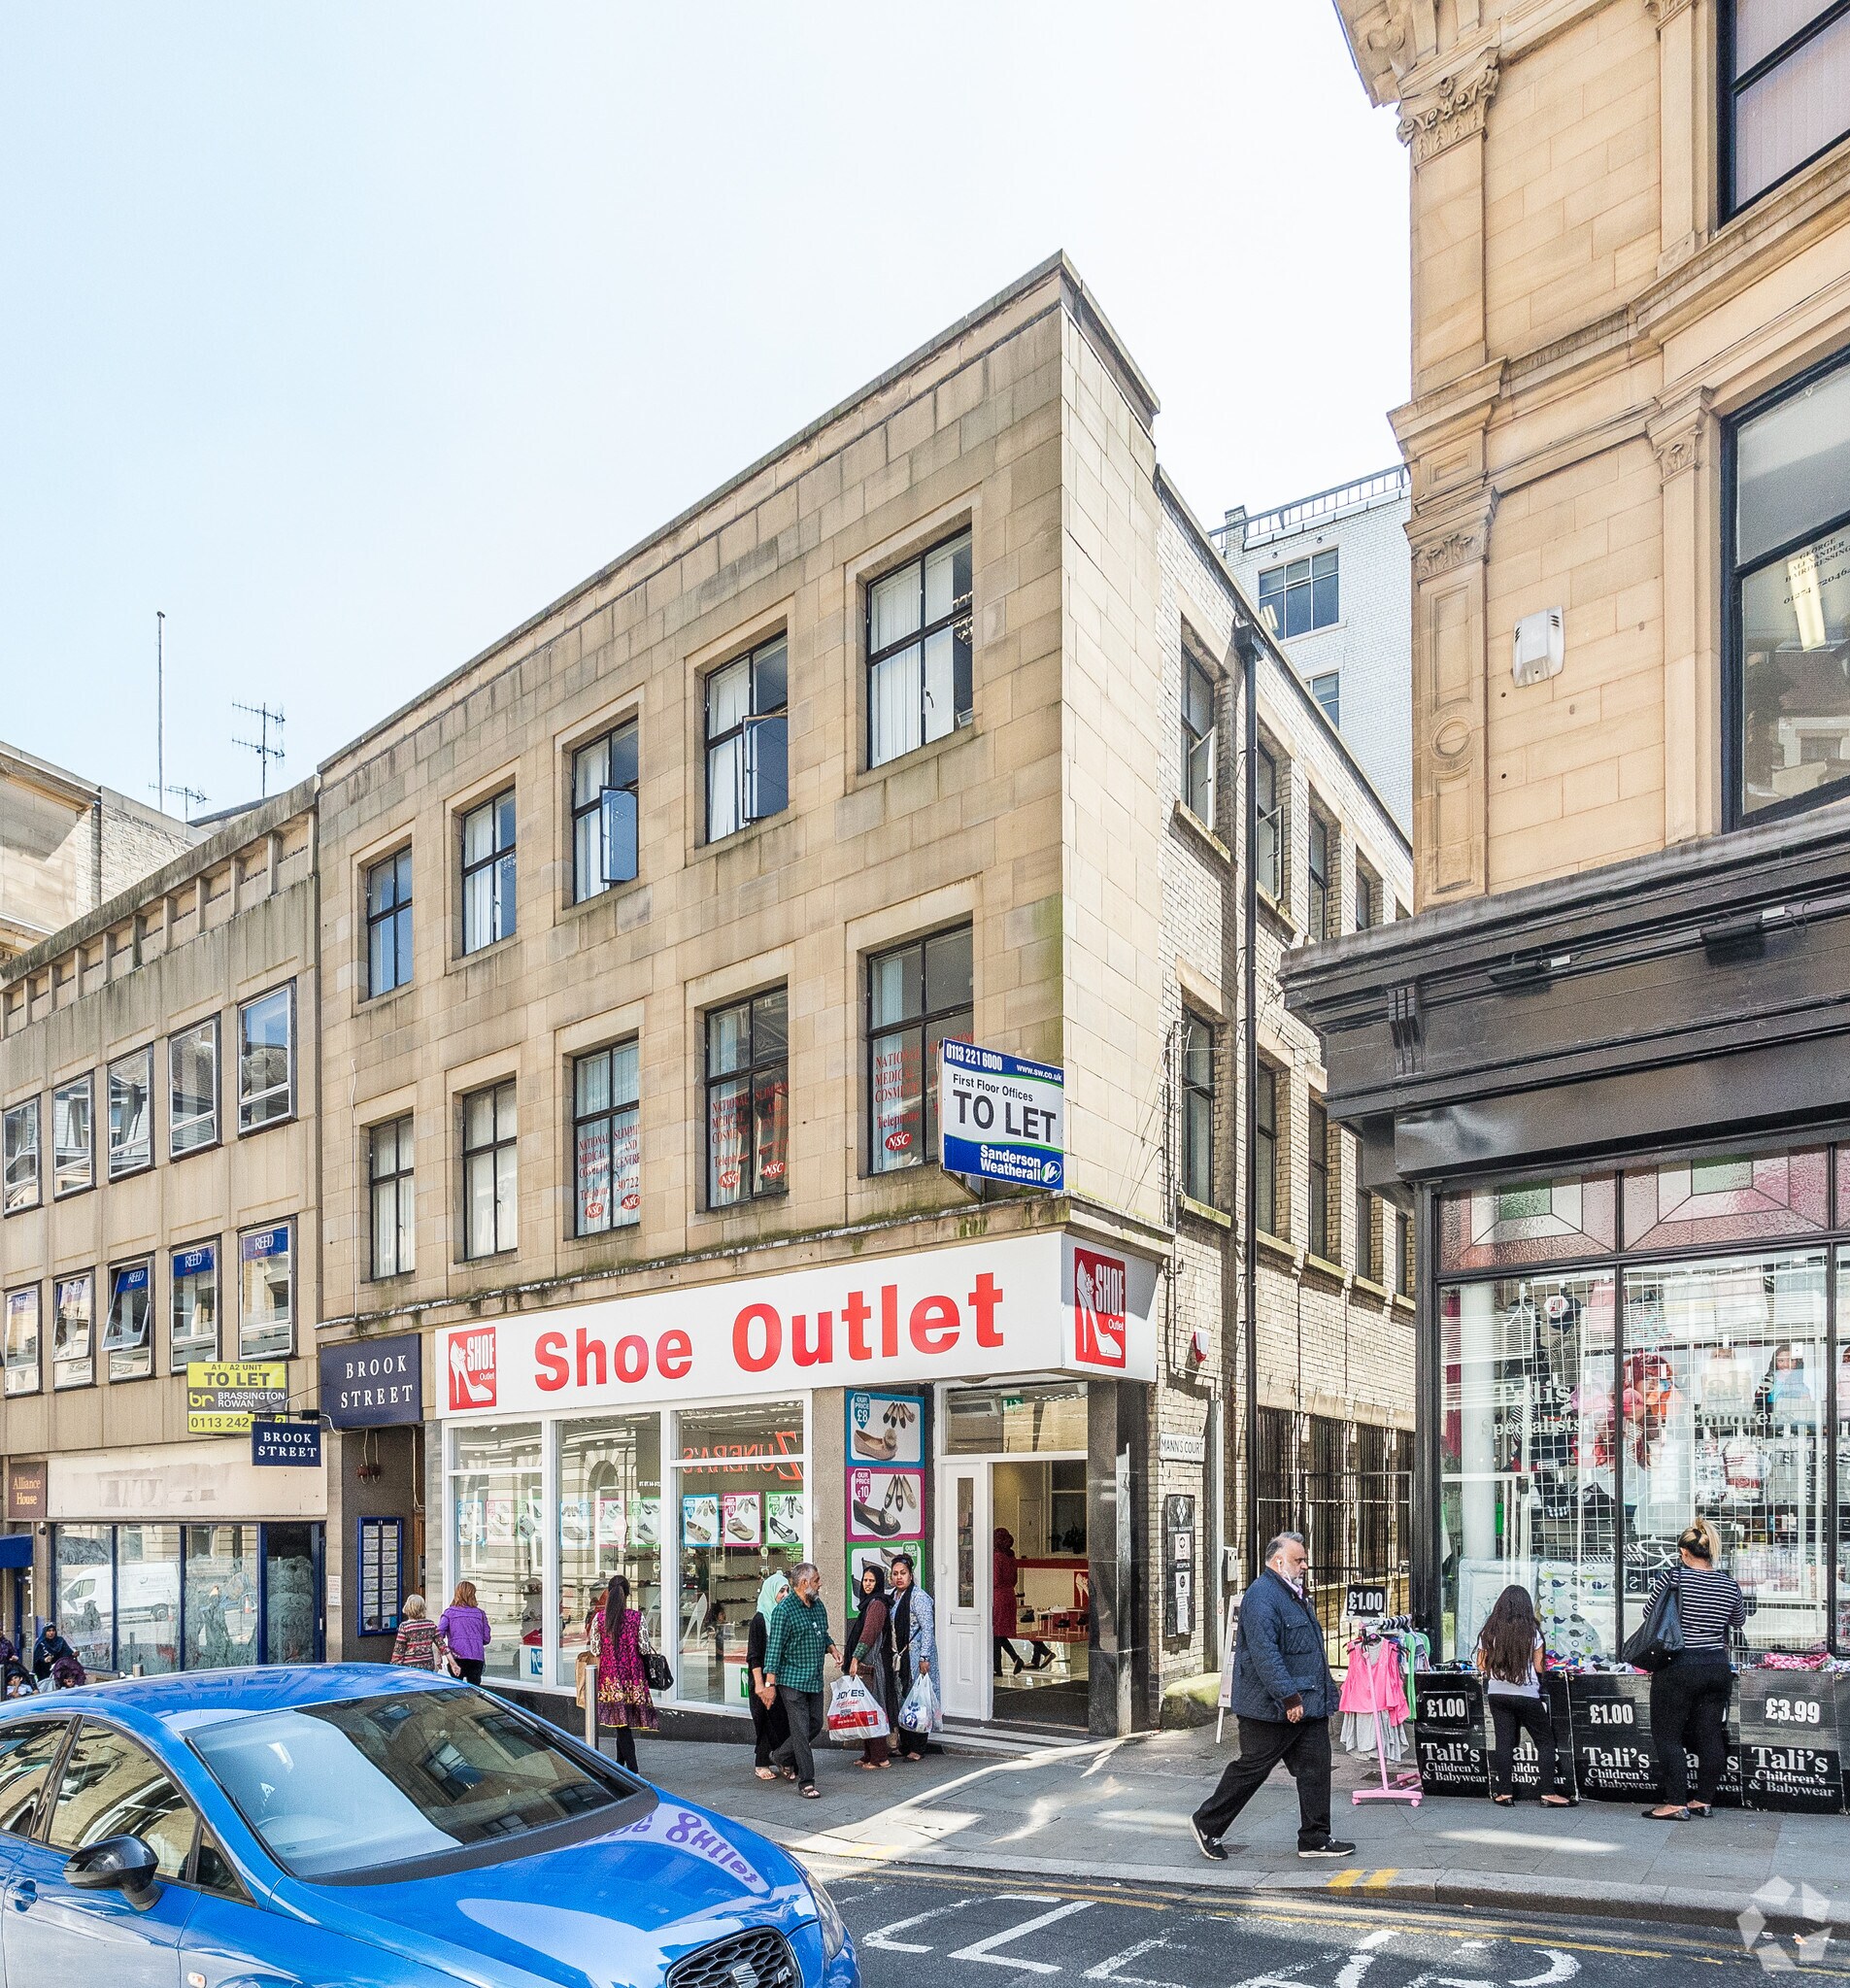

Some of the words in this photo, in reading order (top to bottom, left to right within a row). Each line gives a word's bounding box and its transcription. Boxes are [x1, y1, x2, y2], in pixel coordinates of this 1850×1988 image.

[1800, 537, 1836, 559] GEORGE
[946, 1042, 963, 1061] 0113
[965, 1049, 981, 1065] 221
[982, 1053, 1002, 1071] 6000
[1016, 1063, 1062, 1083] www.sw.co.uk
[953, 1073, 974, 1089] First
[977, 1079, 999, 1095] Floor
[1002, 1085, 1033, 1102] Offices
[953, 1090, 994, 1129] TO
[1005, 1101, 1057, 1143] LET
[579, 1132, 609, 1151] NATIONAL
[888, 1132, 910, 1150] NSC
[579, 1148, 606, 1164] MEDICAL
[624, 1139, 637, 1151] AND
[980, 1144, 1041, 1167] Sanderson
[765, 1162, 784, 1176] NSC
[980, 1157, 1041, 1182] Weatherall
[721, 1171, 739, 1186] NSC
[623, 1194, 640, 1208] NSC
[587, 1204, 601, 1217] NSC
[254, 1233, 274, 1250] REED
[185, 1252, 202, 1267] REED
[127, 1269, 145, 1284] REED
[1095, 1264, 1125, 1317] SHOE
[534, 1327, 693, 1393] Shoe
[731, 1272, 1004, 1374] Outlet
[1108, 1319, 1125, 1331] Outlet
[467, 1333, 494, 1372] SHOE
[346, 1355, 407, 1379] BROOK
[204, 1371, 229, 1387] TO
[236, 1371, 270, 1387] LET
[480, 1372, 495, 1381] Outlet
[218, 1392, 286, 1400] BRASSINGTON
[218, 1399, 254, 1408] ROWAN
[341, 1384, 414, 1408] STREET
[190, 1417, 221, 1429] 0113
[225, 1417, 250, 1428] 242
[857, 1409, 868, 1423] £8
[263, 1432, 312, 1443] BROOK
[258, 1446, 318, 1458] STREET
[1160, 1439, 1183, 1453] MANN'S
[1184, 1441, 1203, 1454] COURT
[13, 1477, 41, 1491] Alliance
[858, 1485, 869, 1499] £10
[17, 1492, 38, 1505] House
[1348, 1591, 1383, 1610] £1.00
[1427, 1699, 1465, 1717] £1.00
[1590, 1703, 1633, 1724] £1.00
[1765, 1698, 1820, 1724] £3.99
[1421, 1742, 1480, 1762] Tali's
[1583, 1746, 1650, 1769] Tali's
[1751, 1746, 1829, 1772] Tali's
[1426, 1763, 1480, 1773] Children's
[1588, 1768, 1649, 1780] Children's
[1422, 1771, 1432, 1780] &
[1435, 1771, 1488, 1783] Babywear
[1584, 1777, 1595, 1787] &
[1598, 1779, 1658, 1791] Babywear
[1755, 1769, 1826, 1785] Children's
[1748, 1779, 1761, 1790] &
[1766, 1781, 1835, 1797] Babywear
